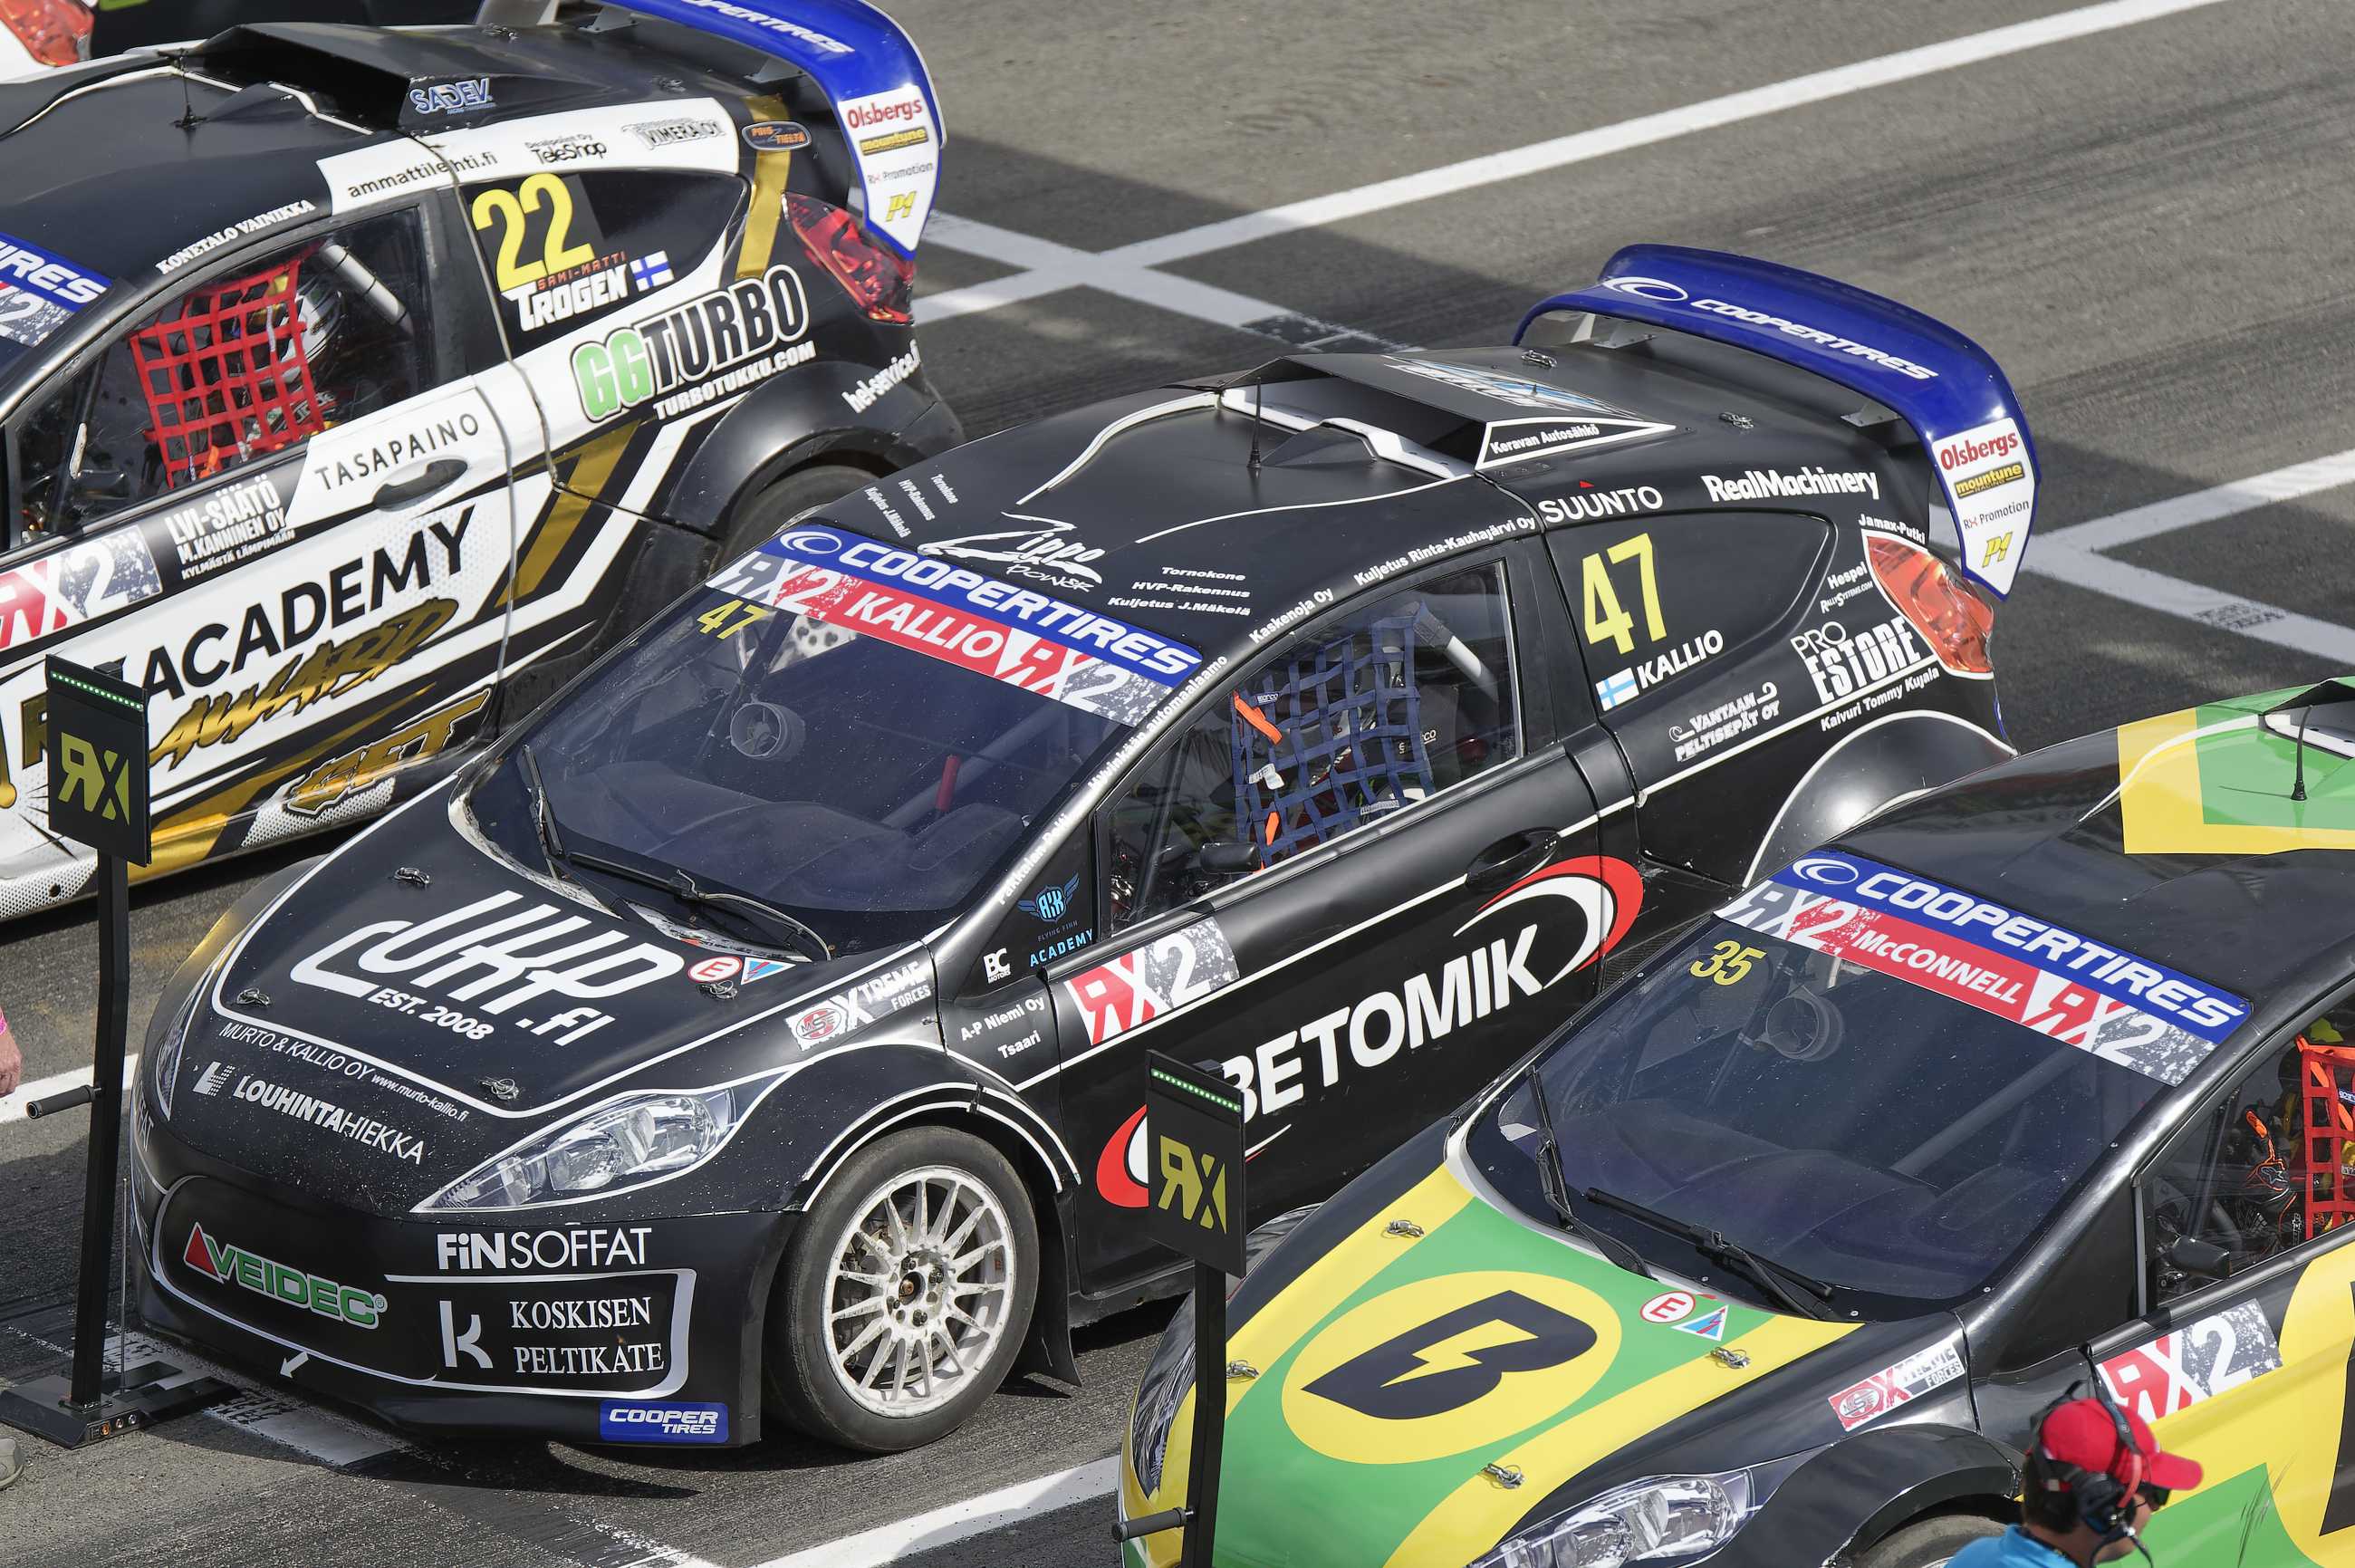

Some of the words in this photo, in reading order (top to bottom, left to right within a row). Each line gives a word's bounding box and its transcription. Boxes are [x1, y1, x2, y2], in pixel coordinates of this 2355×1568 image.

[409, 78, 491, 114] SADEV
[848, 100, 922, 128] Olsbergs
[531, 142, 607, 164] TeleShop
[882, 162, 933, 181] Promotion
[348, 153, 498, 197] ammattilehti.fi
[155, 226, 239, 274] KONETALO
[235, 200, 316, 234] VAINIKKA
[472, 173, 595, 292] 22
[537, 251, 627, 290] SAMI-MATTI
[501, 264, 630, 332] TROGEN
[653, 341, 817, 420] TURBOTUKKU.COM
[315, 413, 480, 491] TASAPAINO
[1490, 434, 1540, 455] Keravan
[1540, 423, 1600, 444] Autosähkö
[1940, 432, 2018, 470] Olsbergs
[1956, 463, 2023, 494] mountune
[164, 474, 282, 544] LVI-SÄÄTÖ
[265, 507, 287, 532] OY
[1537, 486, 1663, 524] SUUNTO
[1980, 500, 2030, 524] Promotion
[1858, 513, 1927, 544] Jamax-Putki
[1353, 554, 1408, 587] Kuljetus
[1408, 519, 1516, 563] Rinta-Kauhajärvi
[1515, 515, 1536, 531] Oy
[1132, 581, 1251, 598] HVP-Rakennus
[1162, 566, 1246, 581] Tornokone
[1827, 561, 1868, 590] Hespel
[141, 504, 476, 701] ACADEMY
[838, 542, 1204, 676] COOPERTIRES
[1108, 597, 1175, 609] Kuljetus
[1178, 601, 1251, 616] J.Mäkelä
[1581, 533, 1668, 655] 47
[696, 599, 770, 640] 47
[844, 591, 1004, 659] KALLIO
[1248, 598, 1315, 644] Kaskenoja
[1313, 587, 1335, 603] Oy
[1637, 630, 1724, 688] KALLIO
[1790, 621, 1847, 660] PRO
[1146, 654, 1229, 736] automaalaamo
[1861, 685, 1903, 712] Tommy
[1905, 666, 1940, 693] Kujala
[1689, 692, 1757, 733] VANTAAN
[1761, 700, 1780, 721] OY
[1030, 928, 1093, 967] ACADEMY
[1037, 927, 1061, 943] FLYING
[1062, 919, 1079, 932] FINN
[1855, 871, 2246, 1028] COOPERTIRES
[984, 948, 1011, 978] BC
[987, 969, 1012, 985] MOTORS
[1689, 939, 1767, 986] 35
[1852, 931, 2024, 1005] McCONNELL
[368, 987, 428, 1015] EST.
[418, 1005, 495, 1041] 2008
[890, 985, 932, 1011] FORCES
[960, 1019, 983, 1041] A-P
[984, 1004, 1024, 1031] Niemi
[1025, 996, 1045, 1013] Oy
[997, 1029, 1042, 1060] Tsaari
[219, 1022, 275, 1048] MURTO
[273, 1037, 289, 1053] &
[285, 1042, 346, 1071] KALLIO
[344, 1061, 376, 1081] OY
[370, 1073, 470, 1122] www.murto-kallio.fi
[233, 1075, 426, 1166] LOUHINTAHIEKKA
[509, 1296, 651, 1330] KOSKISEN
[513, 1342, 665, 1374] PELTIKATE
[1924, 1361, 1963, 1388] FORCES
[608, 1409, 719, 1425] COOPER
[661, 1423, 717, 1435] TIRES
